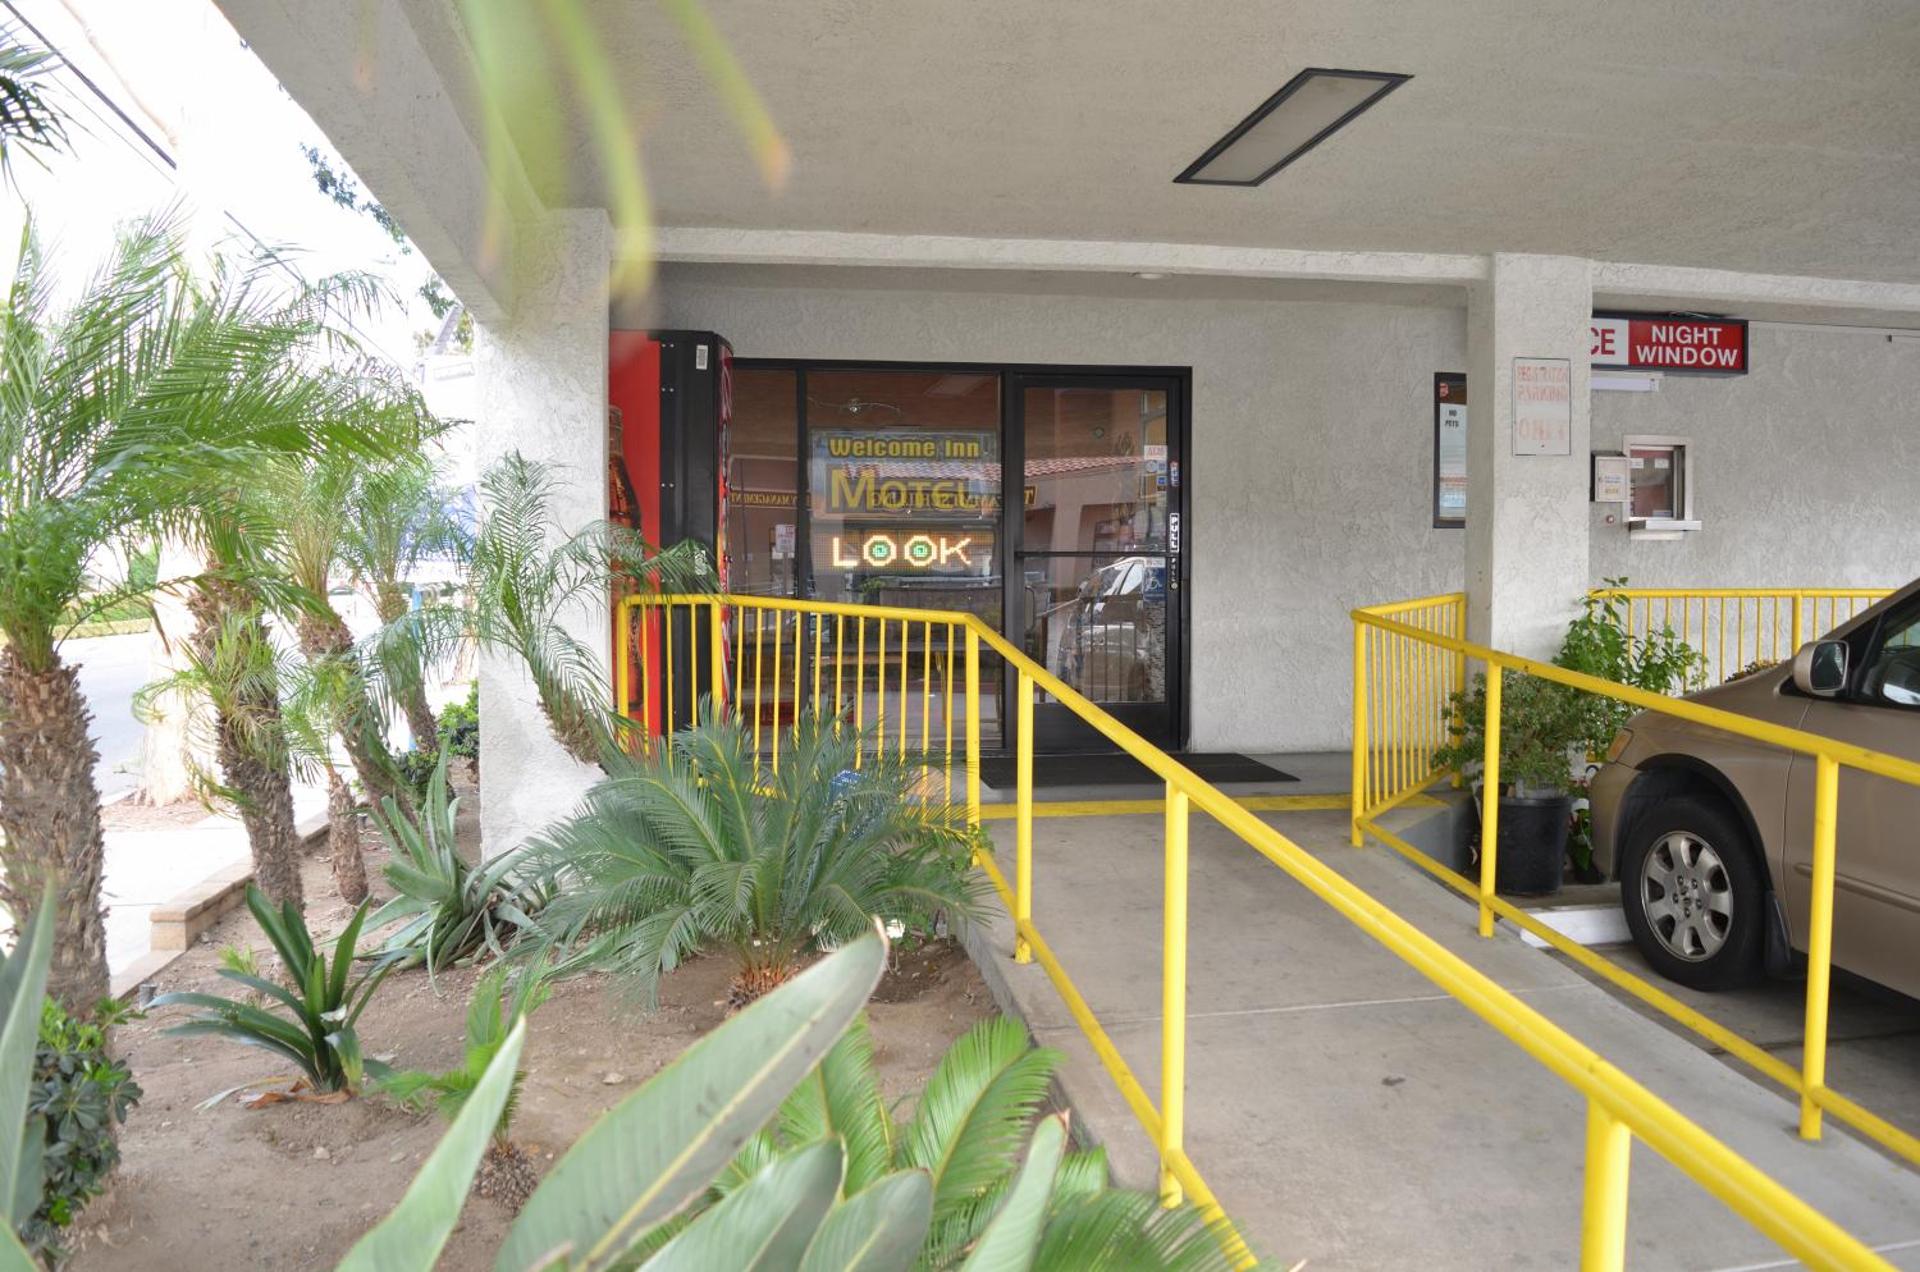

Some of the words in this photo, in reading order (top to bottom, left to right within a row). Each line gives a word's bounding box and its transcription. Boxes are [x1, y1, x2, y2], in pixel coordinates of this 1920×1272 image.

[1651, 325, 1723, 346] NIGHT
[1636, 345, 1739, 367] WINDOW
[829, 438, 936, 458] Welcome
[945, 439, 980, 458] Inn
[1170, 515, 1178, 550] PULL
[832, 535, 972, 567] LOOK
